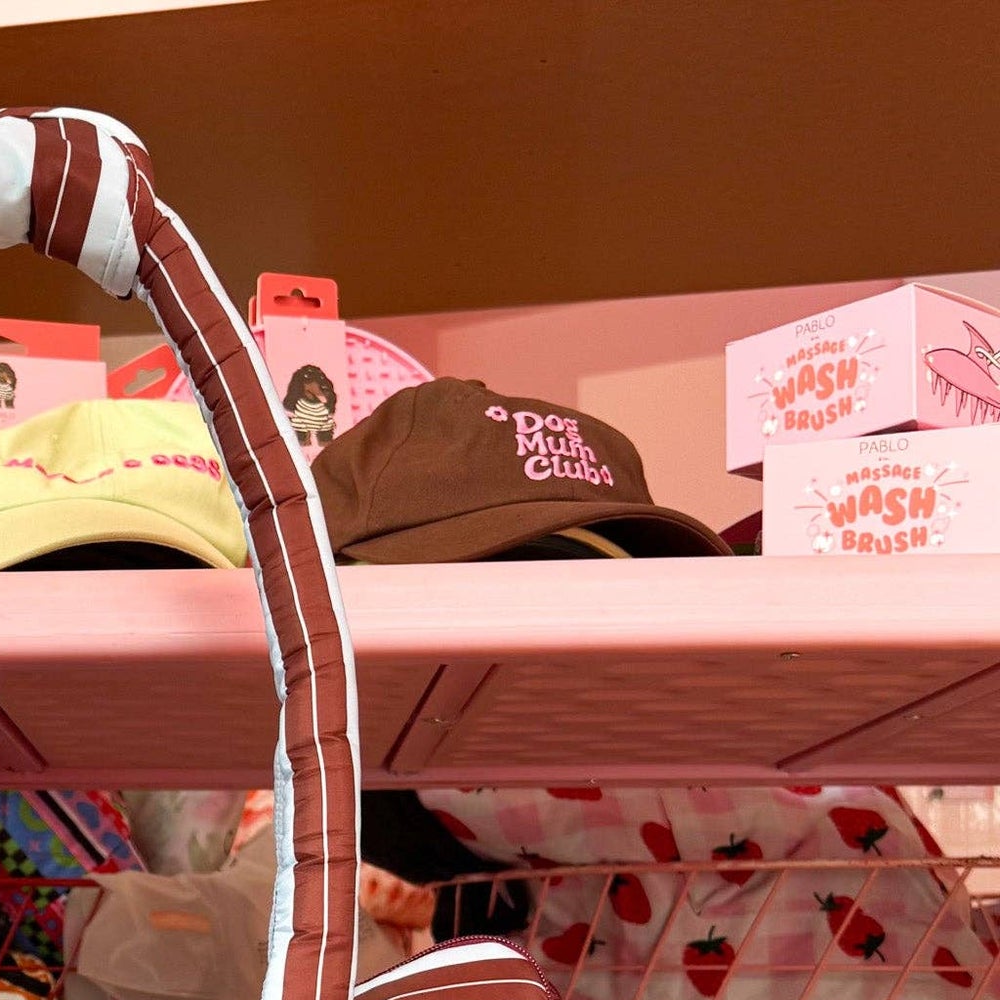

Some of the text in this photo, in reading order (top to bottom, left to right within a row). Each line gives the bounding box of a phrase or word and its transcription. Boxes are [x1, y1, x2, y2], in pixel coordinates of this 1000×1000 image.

[795, 315, 836, 338] PABLO
[786, 340, 846, 369] MASSAGE
[773, 357, 859, 410] WASH
[784, 396, 853, 431] BRUSH
[515, 432, 597, 463] Mum
[859, 438, 909, 455] PABLO
[524, 455, 601, 486] Club
[846, 464, 921, 485] MASSAGE
[827, 485, 936, 527] WASH
[842, 526, 928, 555] BRUSH
